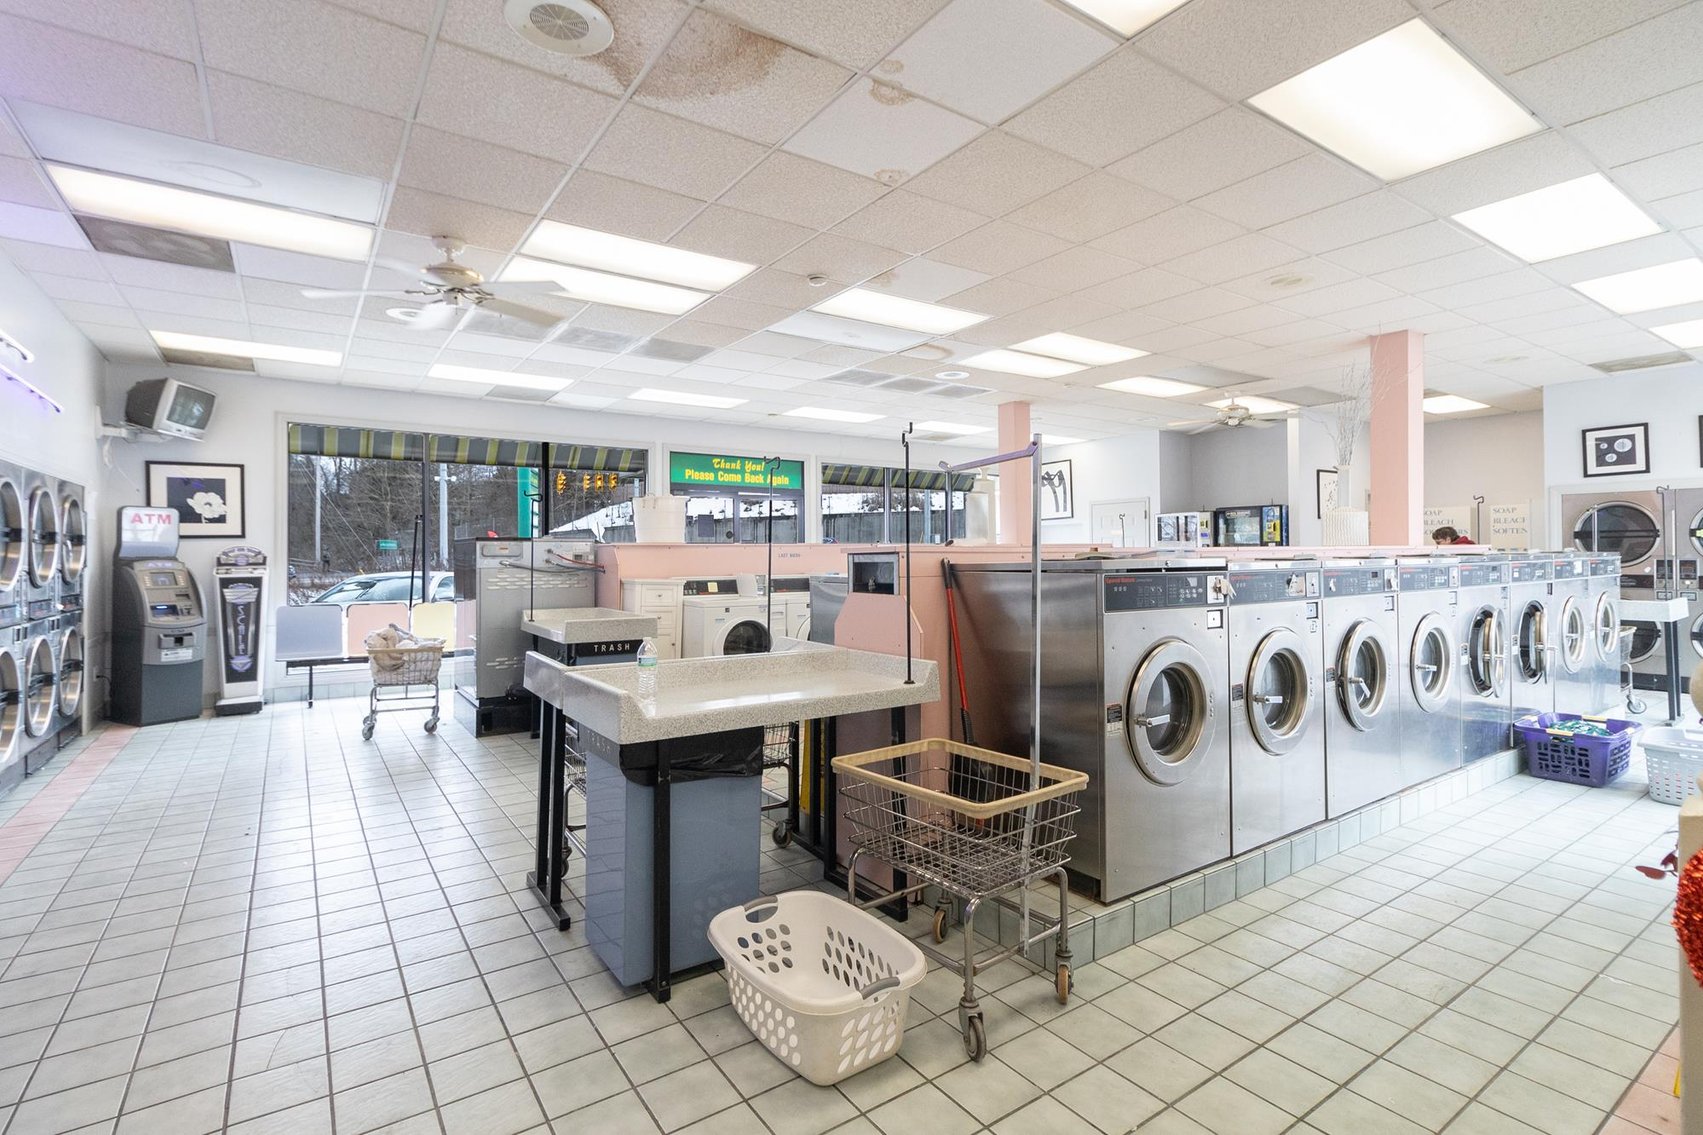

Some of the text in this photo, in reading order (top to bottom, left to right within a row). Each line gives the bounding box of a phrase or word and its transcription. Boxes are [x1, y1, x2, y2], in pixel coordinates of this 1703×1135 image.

[712, 458, 765, 472] Thank You!
[685, 469, 715, 481] Please
[718, 471, 742, 482] Come
[745, 472, 765, 484] Back
[130, 512, 172, 525] ATM
[237, 605, 246, 655] SCALE
[594, 643, 630, 652] TRASH
